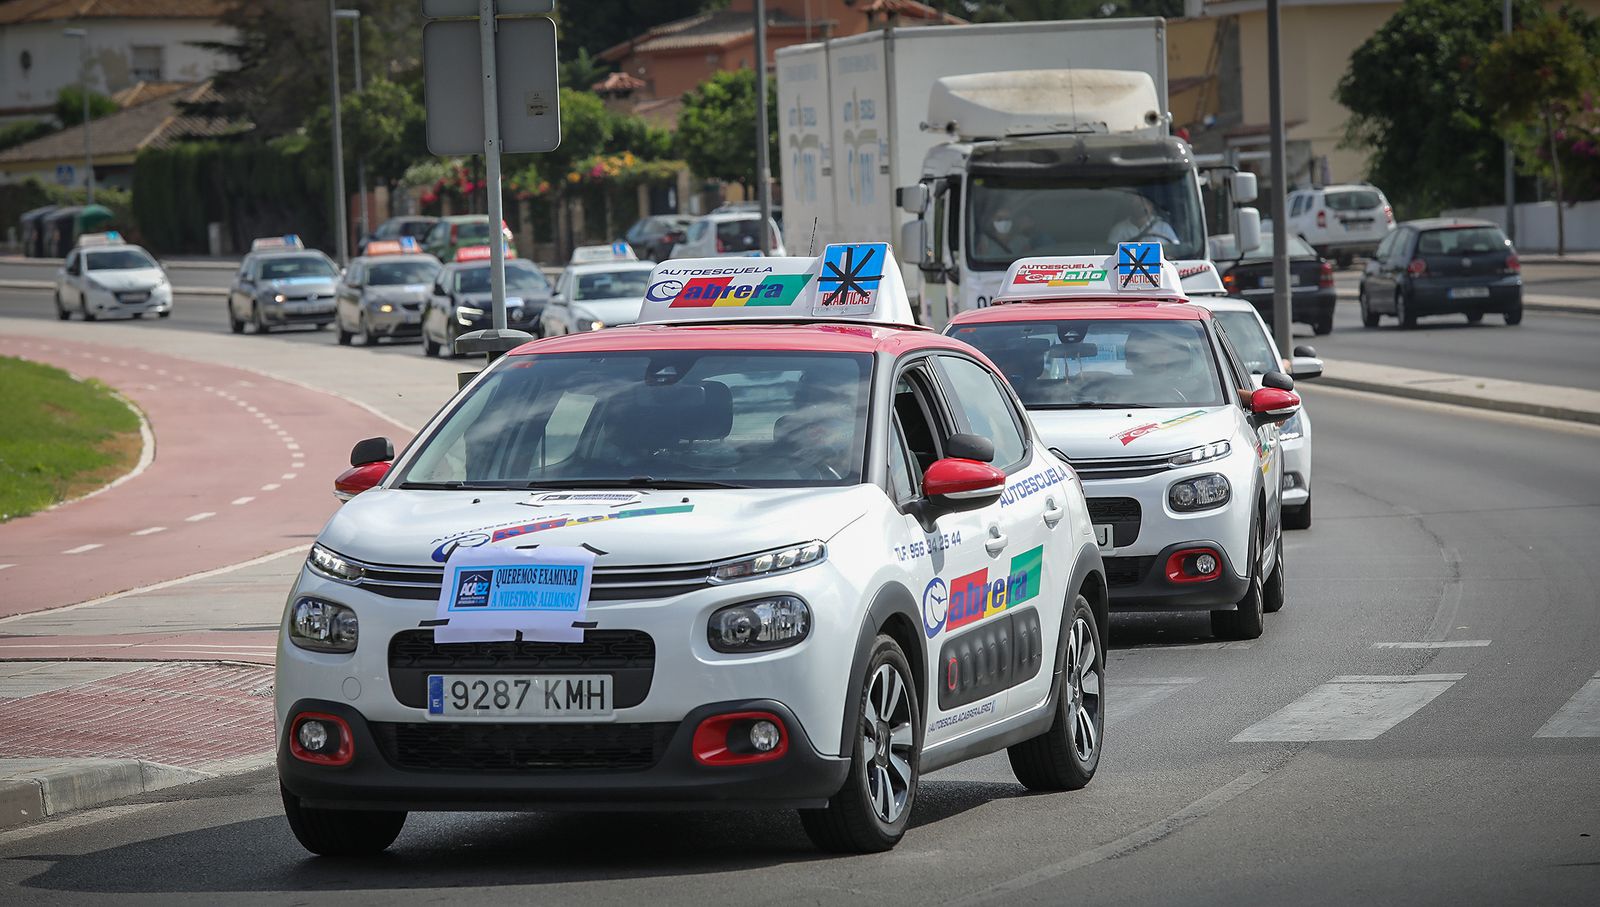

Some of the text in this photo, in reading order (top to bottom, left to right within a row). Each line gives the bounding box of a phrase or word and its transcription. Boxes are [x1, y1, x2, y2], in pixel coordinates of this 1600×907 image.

[657, 266, 773, 276] AUTOESCUELA
[1120, 275, 1159, 283] PRACTICS
[646, 279, 784, 302] Cabrera
[822, 291, 870, 306] PRATICAS
[1000, 464, 1068, 508] AUTOESCUELA
[909, 541, 925, 559] 956
[926, 537, 938, 554] 34
[939, 534, 950, 550] 25
[951, 530, 962, 547] 44
[496, 568, 578, 589] QUEREMOS EXAMINAR
[491, 591, 576, 608] A NUESTROS ALUMNOS
[923, 570, 1028, 639] Cabrera
[451, 680, 605, 710] 9287 KMH
